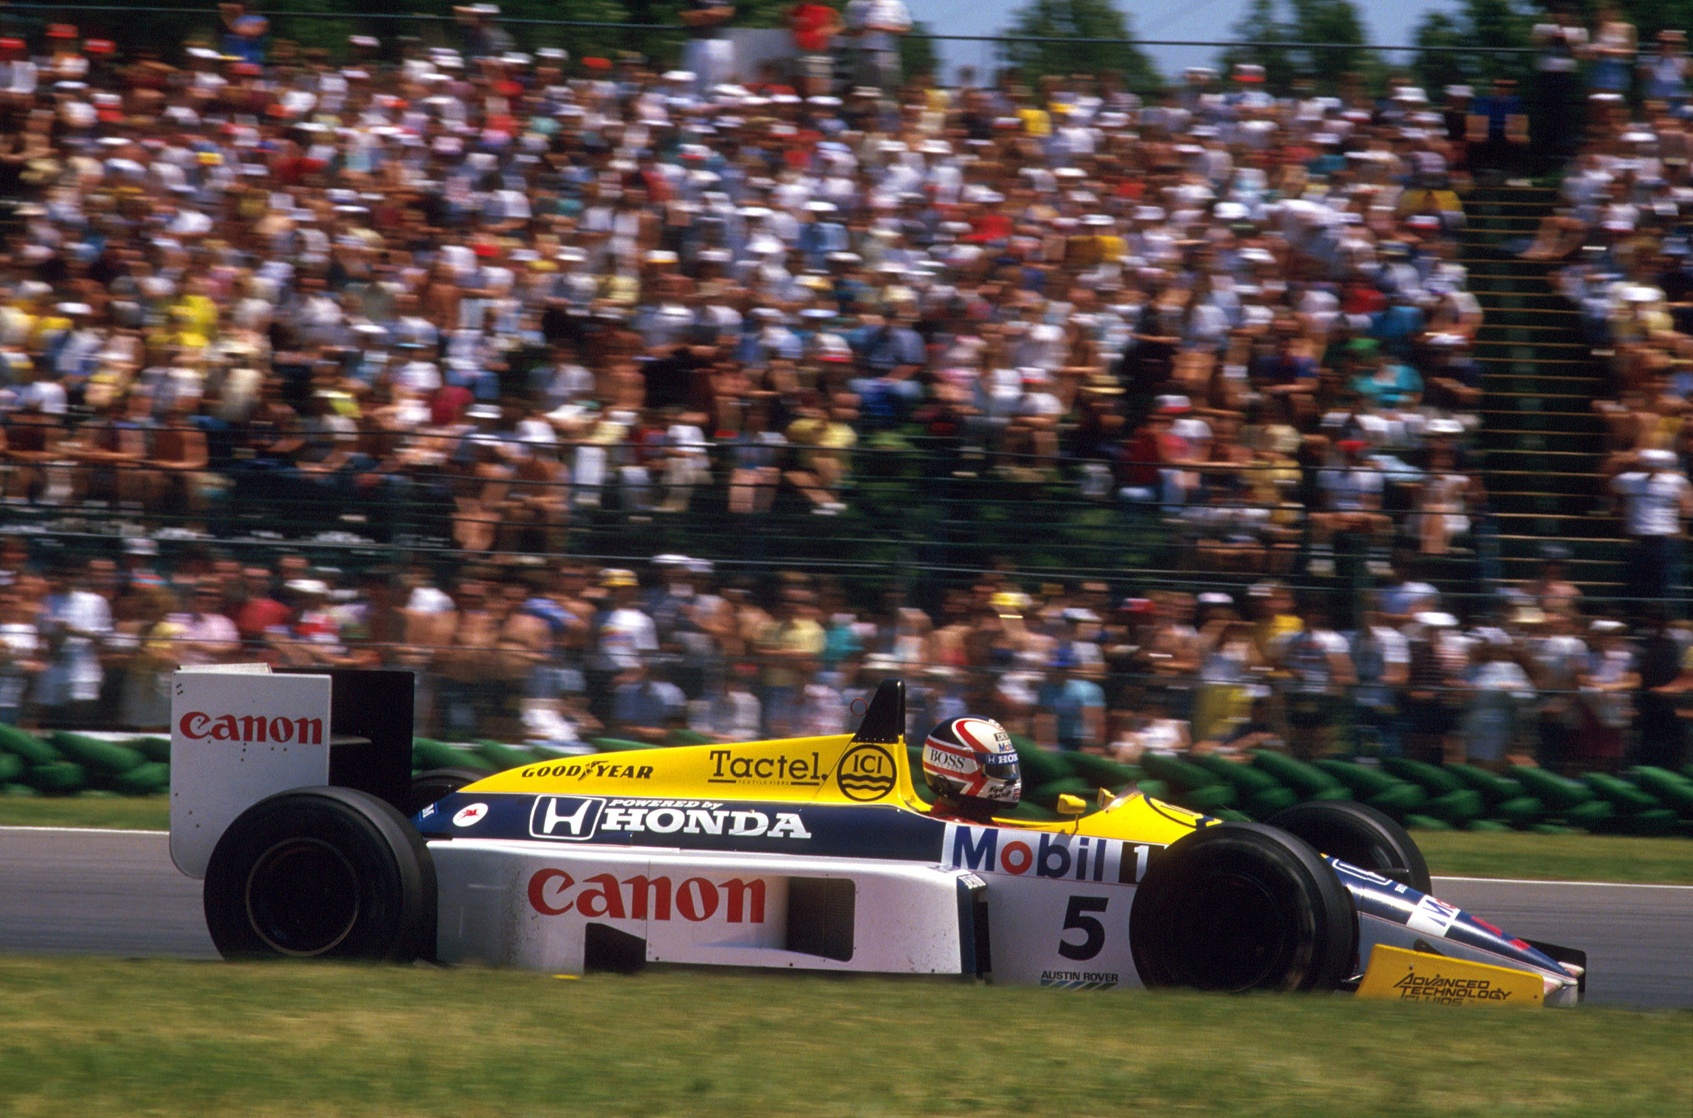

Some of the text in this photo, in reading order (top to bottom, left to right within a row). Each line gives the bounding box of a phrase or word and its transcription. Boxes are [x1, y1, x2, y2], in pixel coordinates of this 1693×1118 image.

[179, 711, 322, 745] Canon
[853, 754, 882, 774] ICI
[930, 749, 965, 770] BOSS
[608, 799, 724, 810] POWERED by
[601, 808, 812, 839] HONDA
[952, 825, 1149, 883] Mobil 1
[528, 867, 766, 923] Canon
[1058, 895, 1109, 961] 5
[1041, 970, 1119, 983] AUSTIN ROVER
[1393, 972, 1491, 990] ADVANCED
[1400, 985, 1512, 1000] TECHNOLOGY
